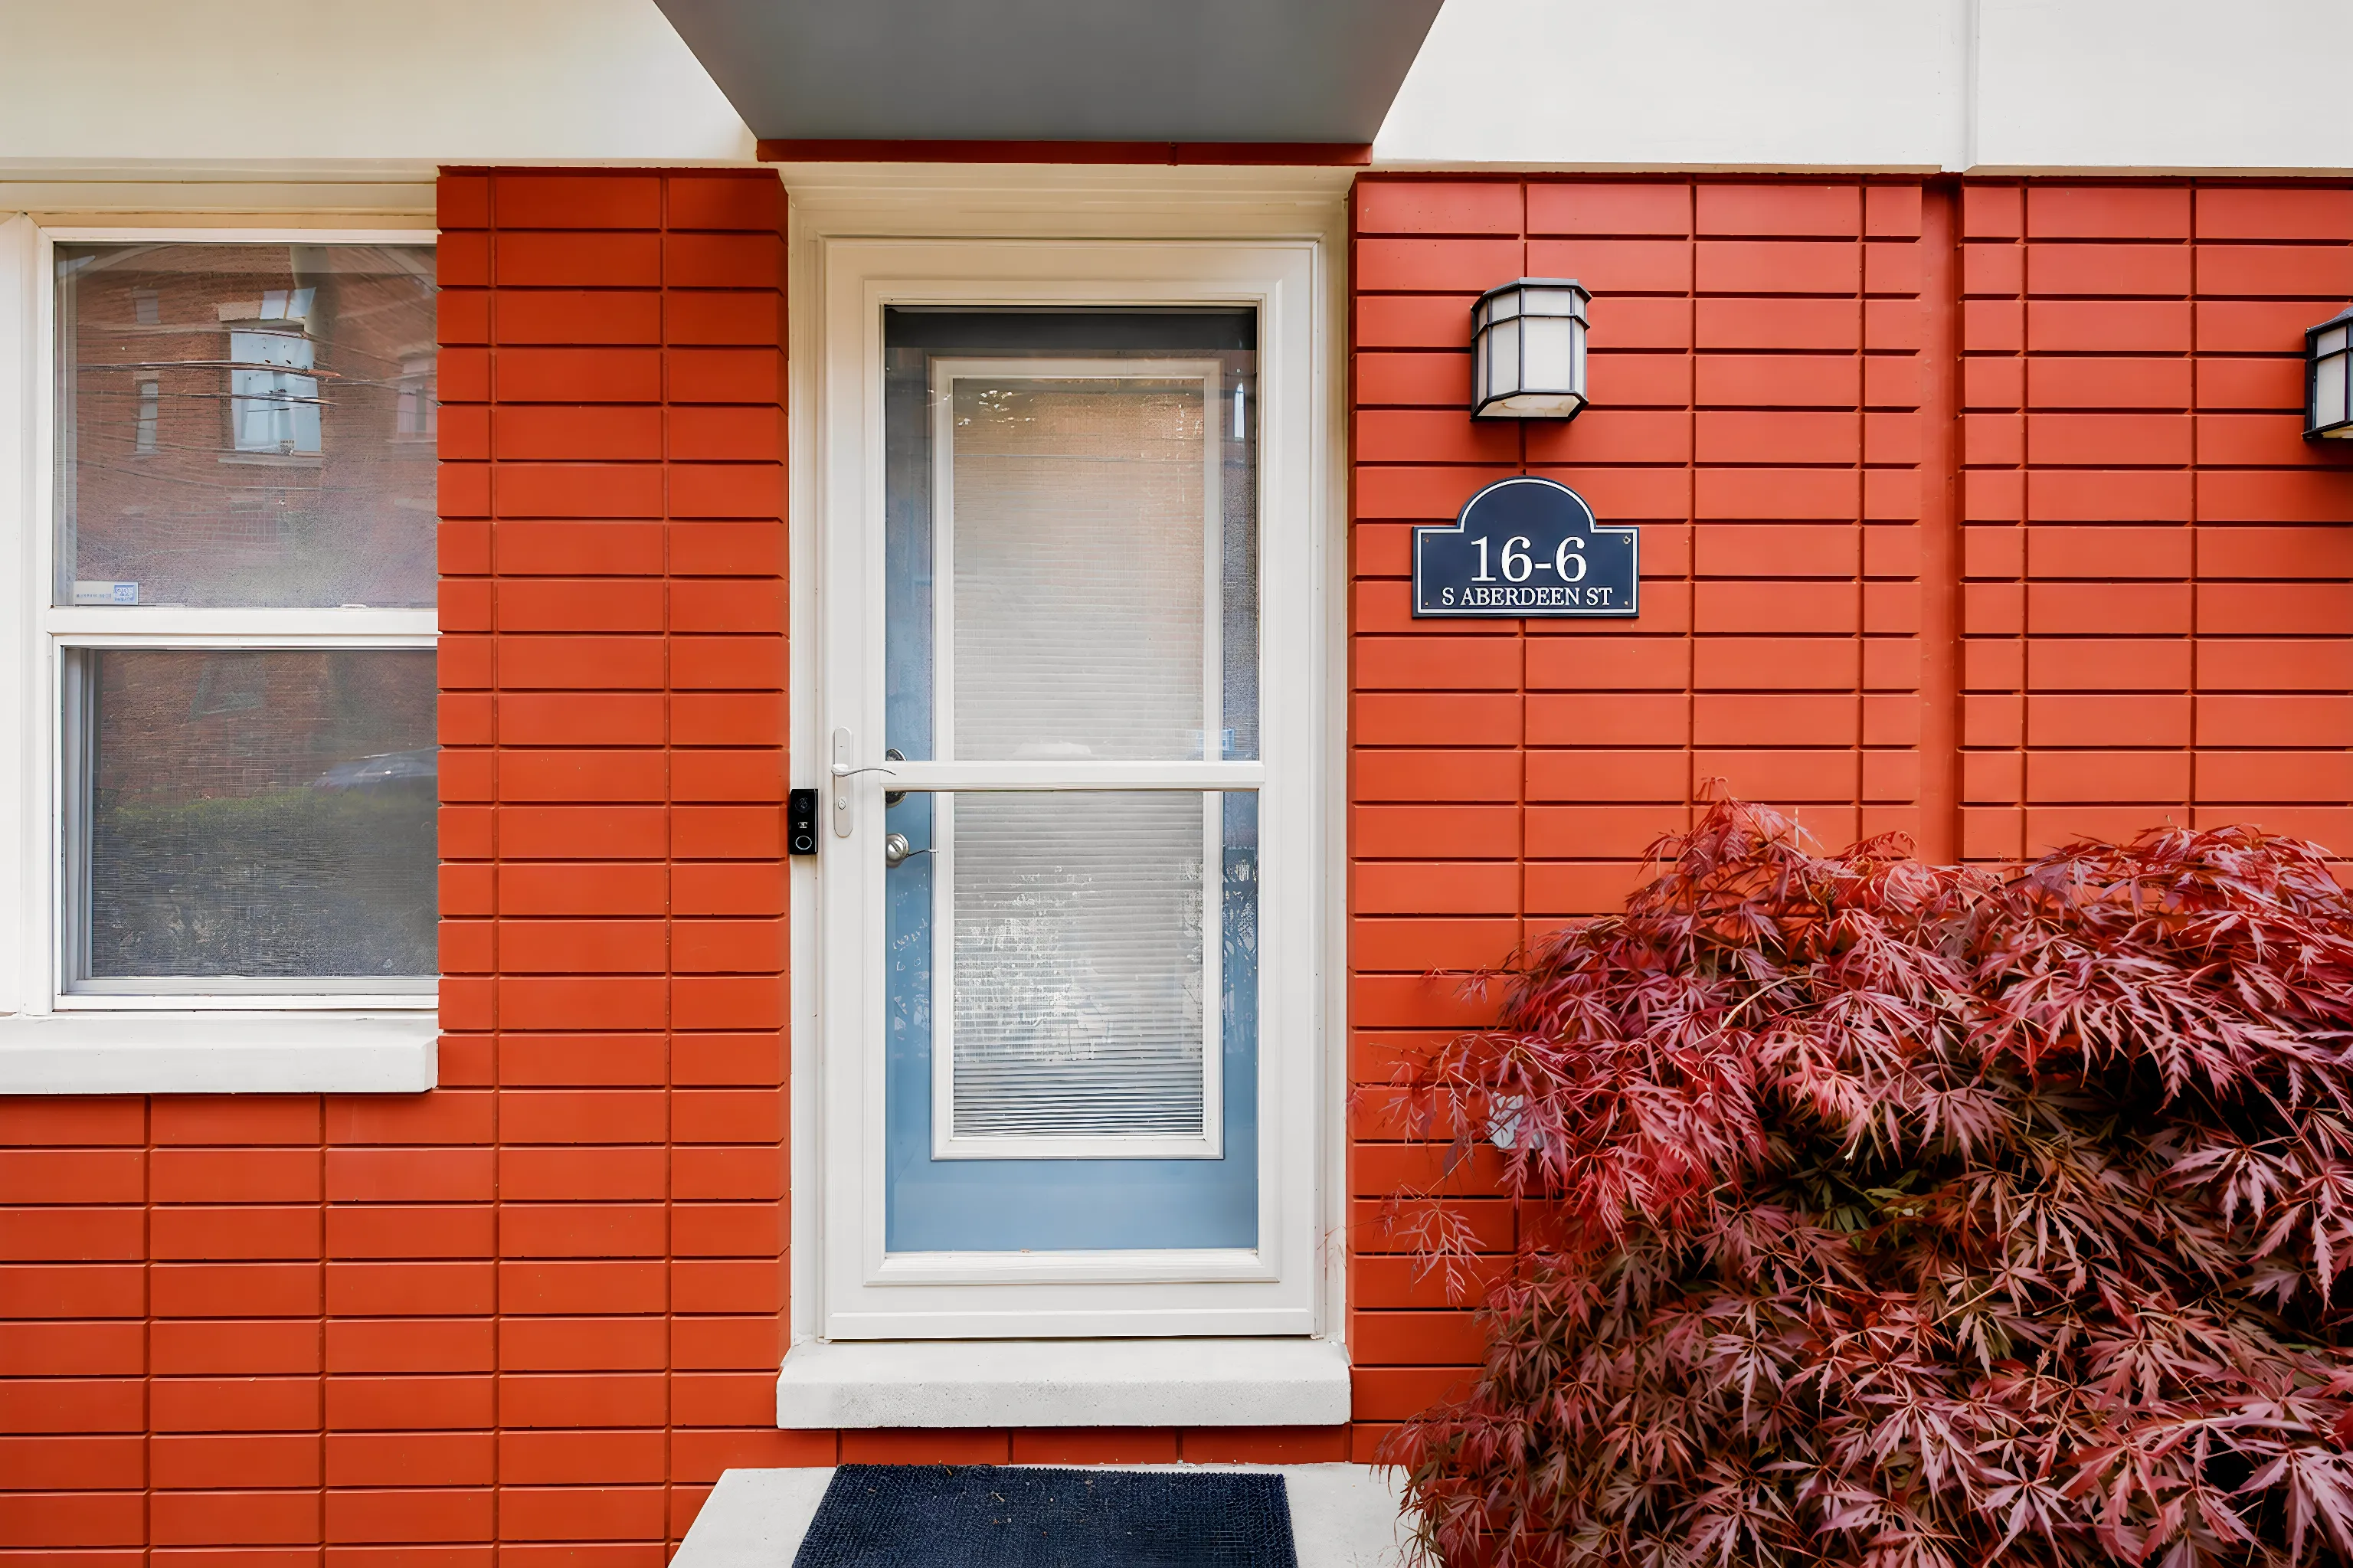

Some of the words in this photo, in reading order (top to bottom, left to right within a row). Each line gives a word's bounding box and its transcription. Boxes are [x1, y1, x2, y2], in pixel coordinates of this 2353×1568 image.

[1471, 536, 1587, 582] 16-6
[1442, 587, 1455, 606] S
[1460, 587, 1579, 606] ABERDEEN
[1586, 587, 1613, 606] ST
